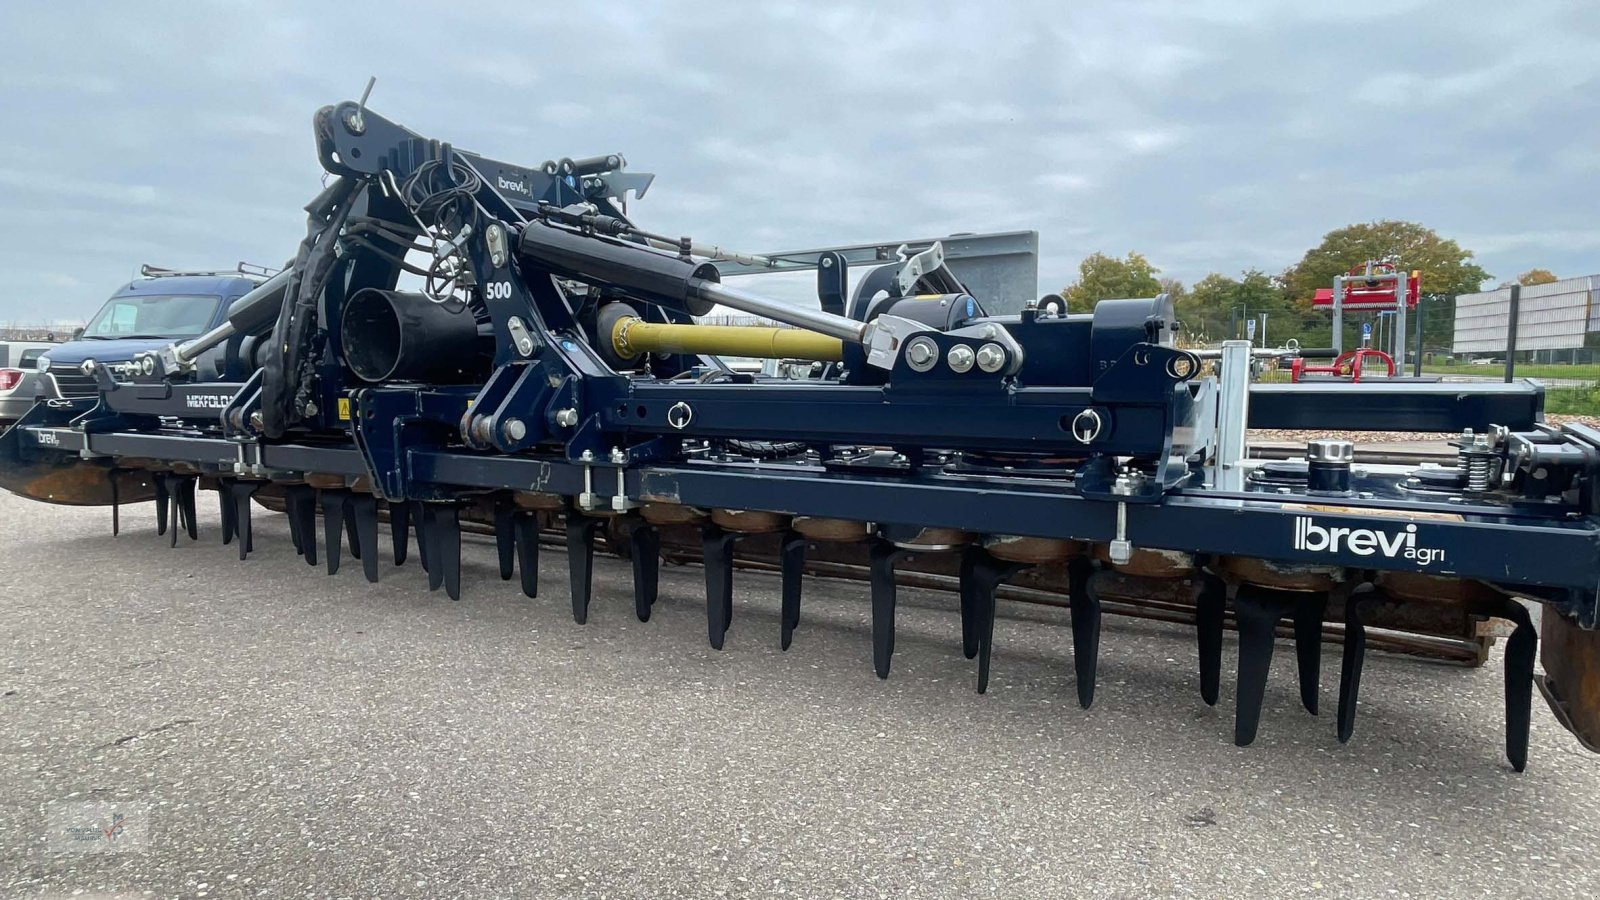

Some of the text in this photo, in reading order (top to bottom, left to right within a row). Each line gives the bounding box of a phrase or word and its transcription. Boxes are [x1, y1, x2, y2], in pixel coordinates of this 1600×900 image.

[498, 176, 523, 192] brevi
[486, 281, 512, 300] 500
[1294, 516, 1446, 566] brevi agri
